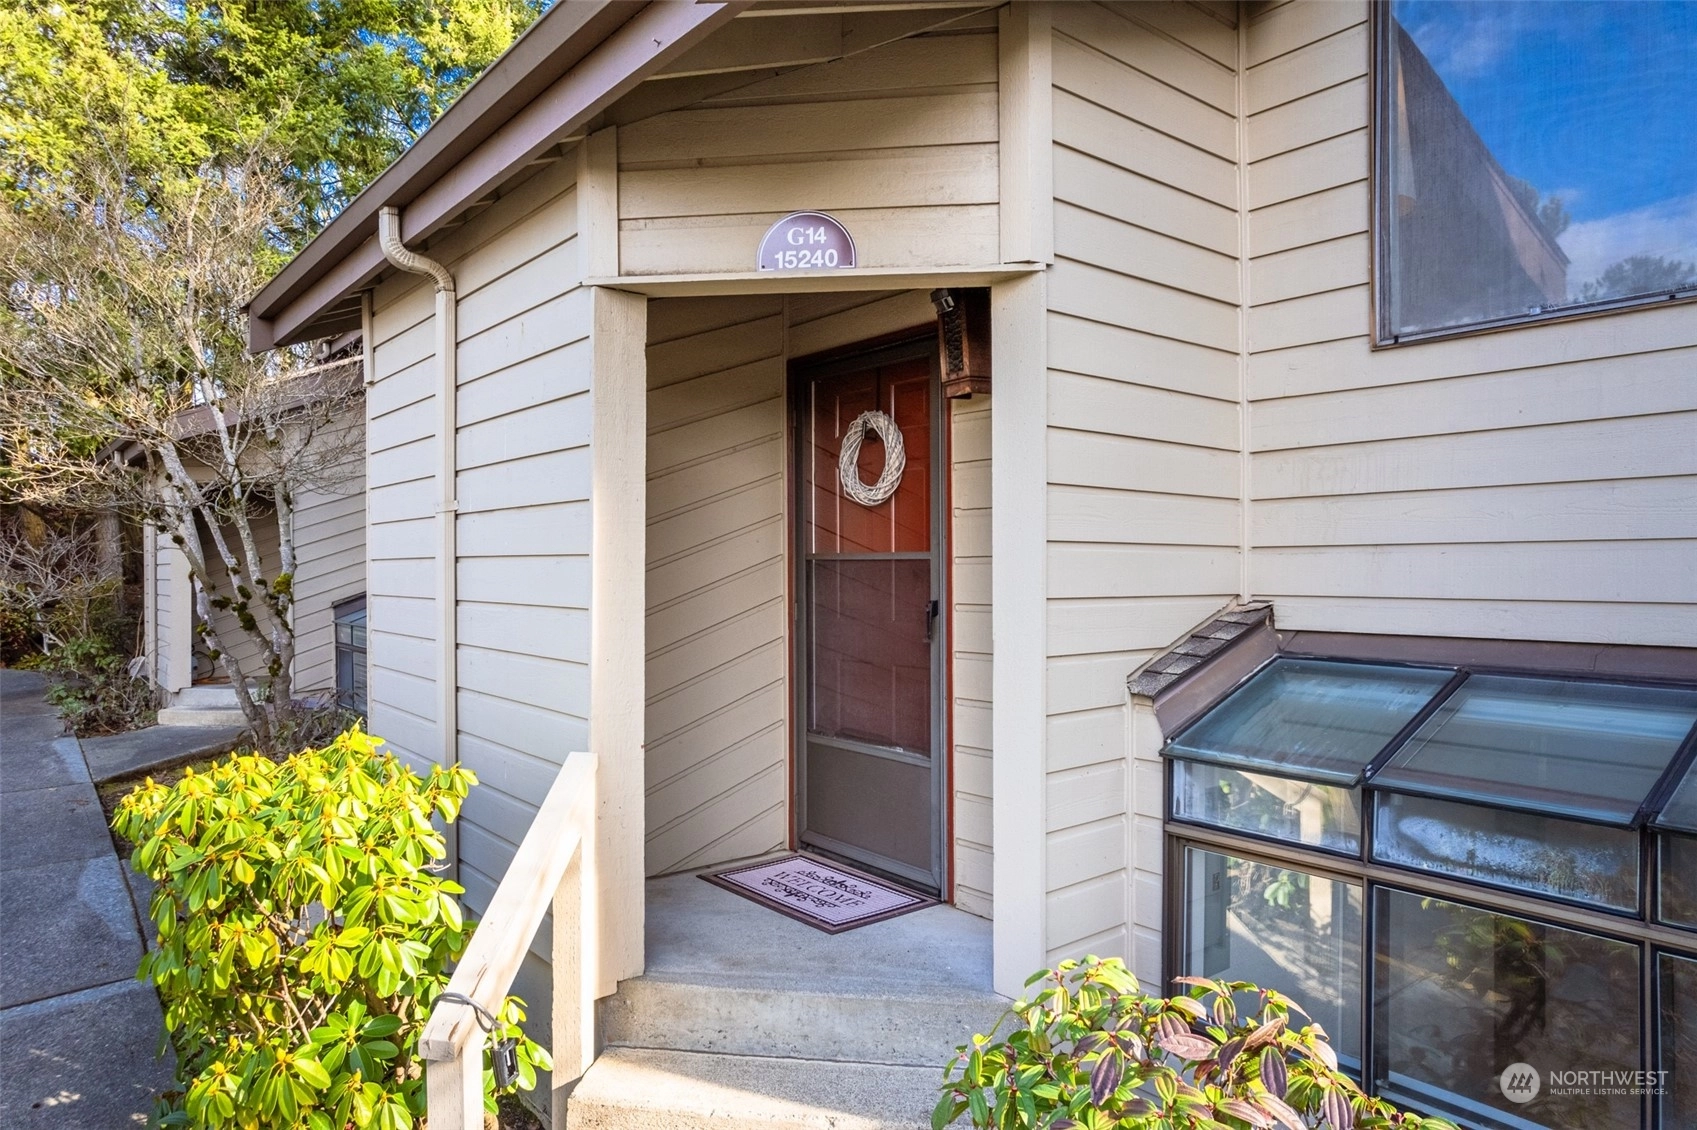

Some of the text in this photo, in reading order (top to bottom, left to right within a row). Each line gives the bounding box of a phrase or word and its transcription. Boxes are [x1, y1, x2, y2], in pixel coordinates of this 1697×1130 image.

[787, 226, 827, 245] G14
[774, 248, 838, 269] 15240
[774, 871, 865, 907] WELCOME
